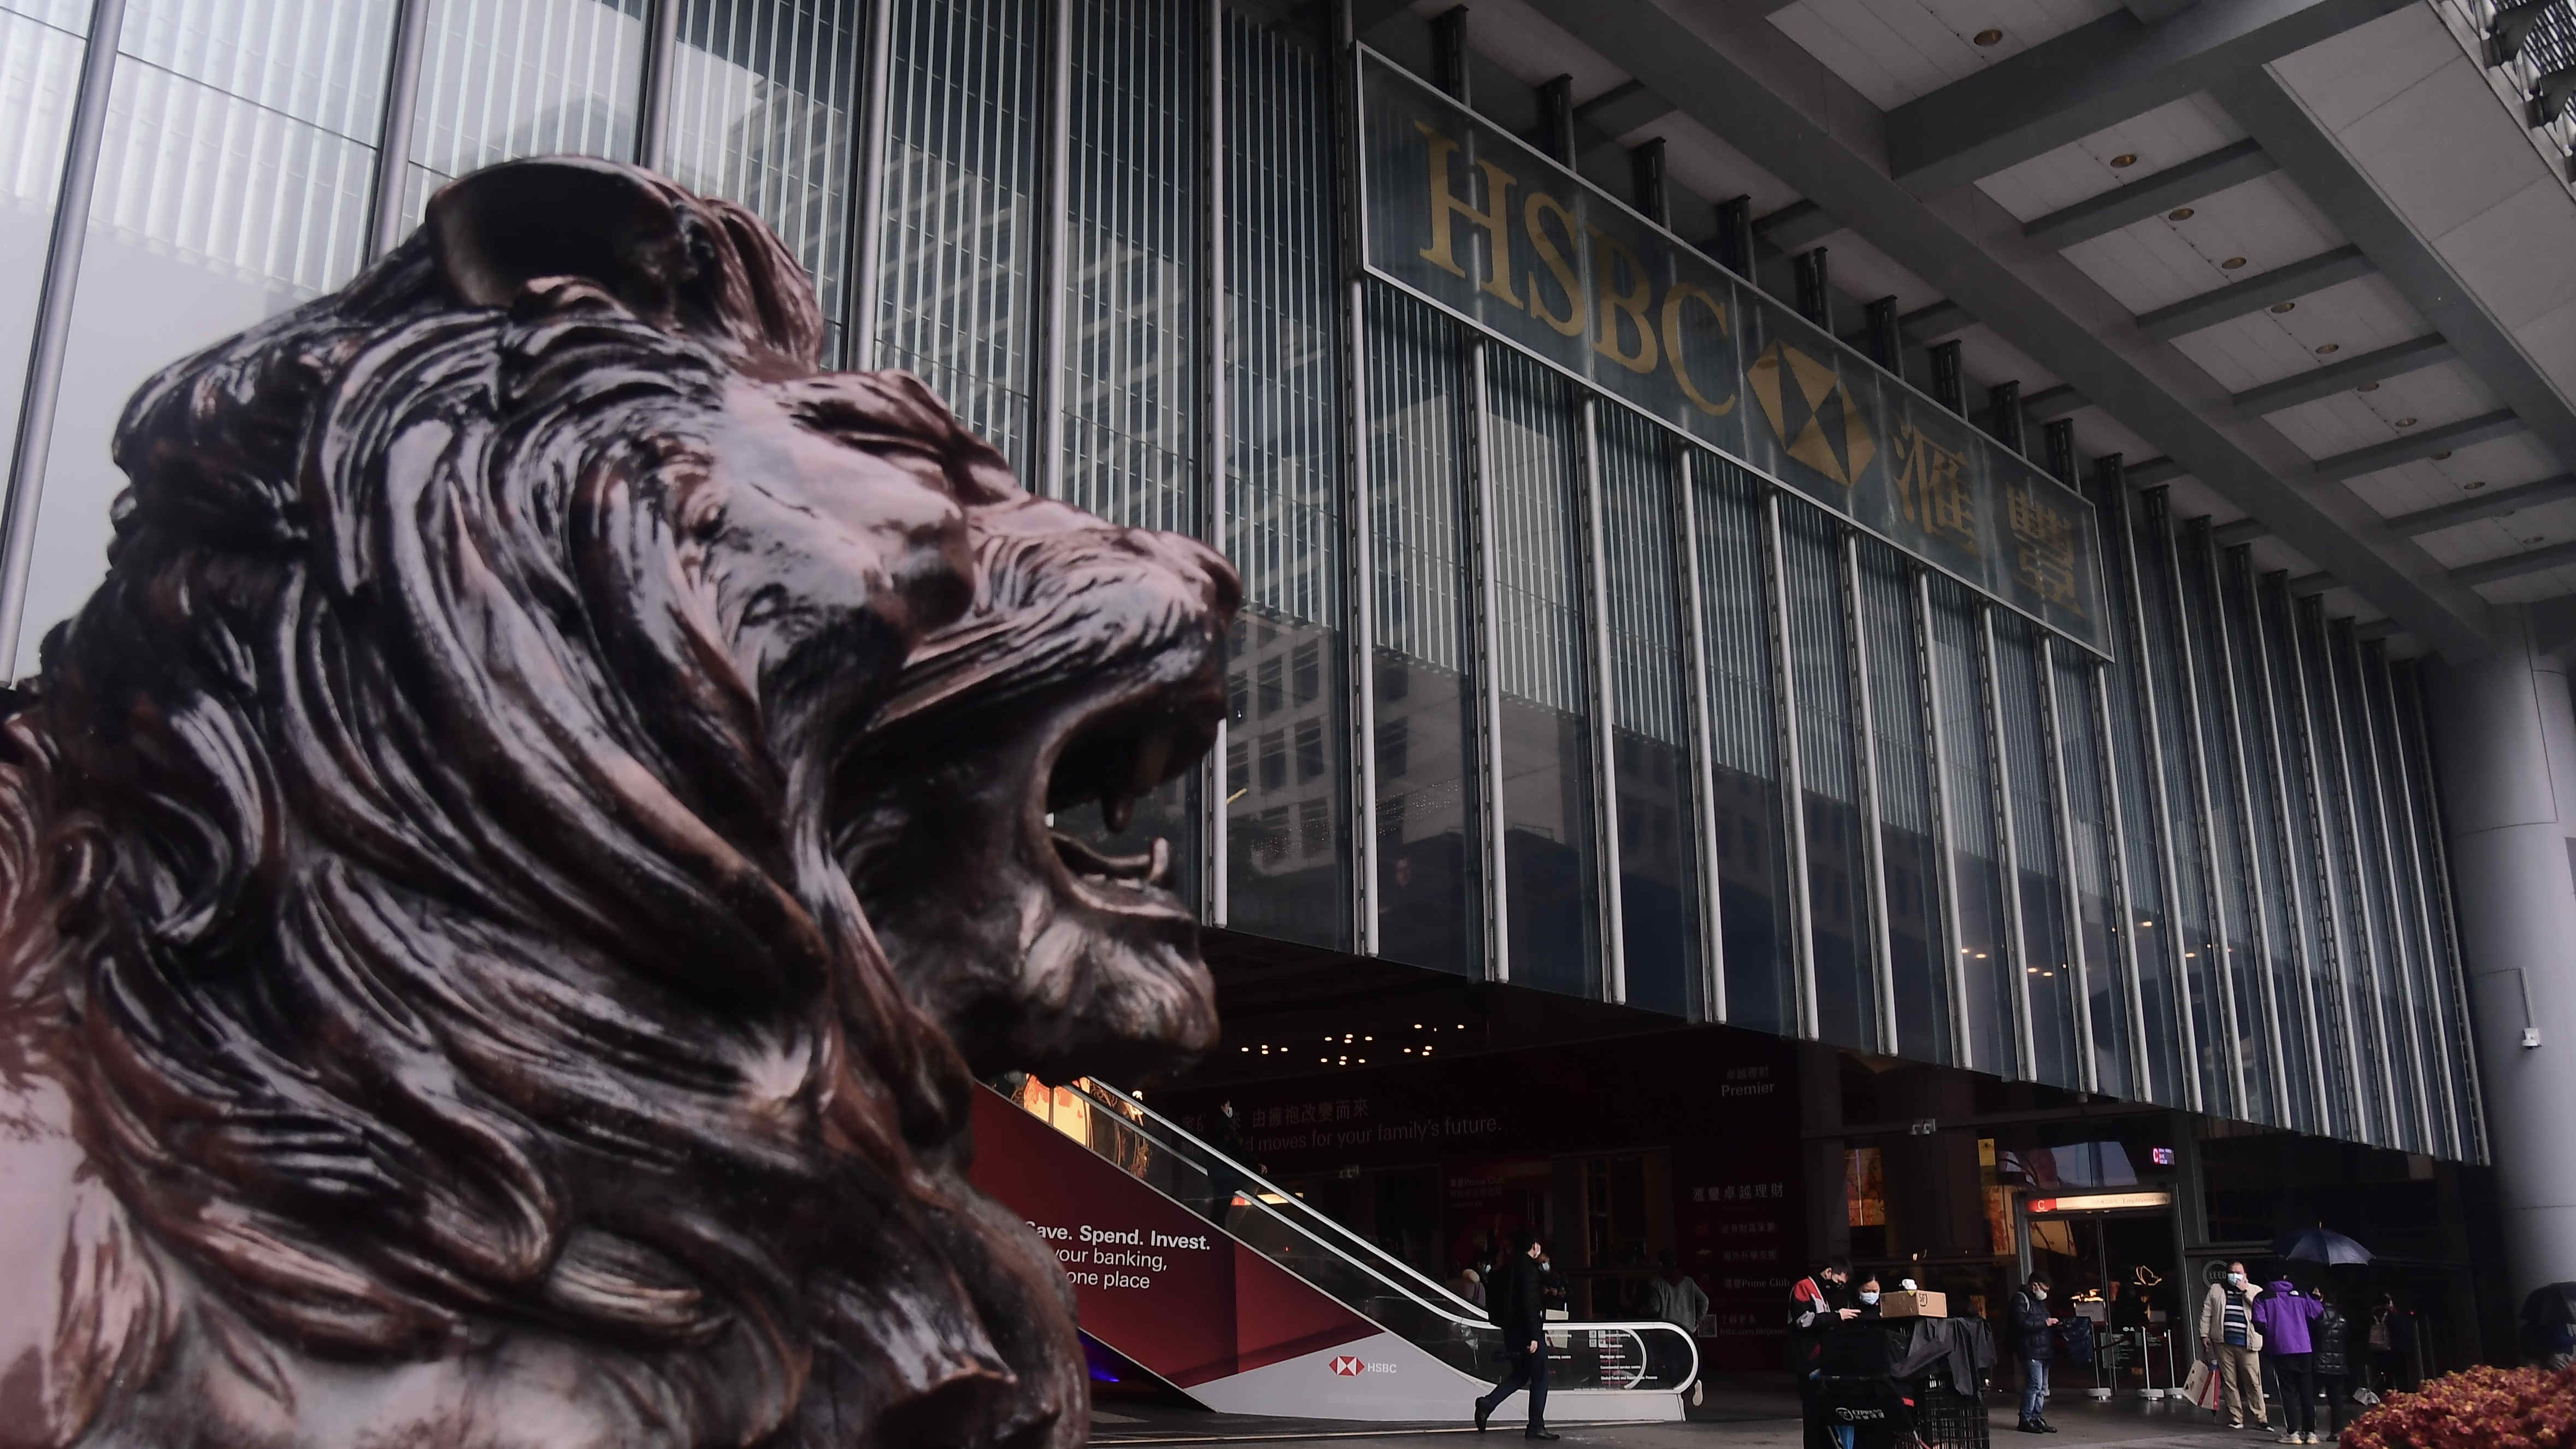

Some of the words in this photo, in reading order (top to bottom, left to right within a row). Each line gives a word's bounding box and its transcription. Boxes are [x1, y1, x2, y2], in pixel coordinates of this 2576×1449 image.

[1414, 119, 1736, 416] HSBC
[1722, 1081, 1775, 1098] Premier
[1258, 1135, 1307, 1152] moves
[1311, 1128, 1333, 1147] for
[1337, 1129, 1373, 1149] your
[1378, 1119, 1440, 1144] family's
[1446, 1116, 1502, 1136] future.
[2153, 1148, 2159, 1163] C
[2036, 1199, 2045, 1210] C
[1079, 1224, 1144, 1246] Spend.
[1151, 1230, 1211, 1250] Invest.
[1093, 1248, 1168, 1272] banking,
[1067, 1271, 1099, 1285] one
[1104, 1270, 1150, 1290] place
[1367, 1362, 1397, 1374] HSBC
